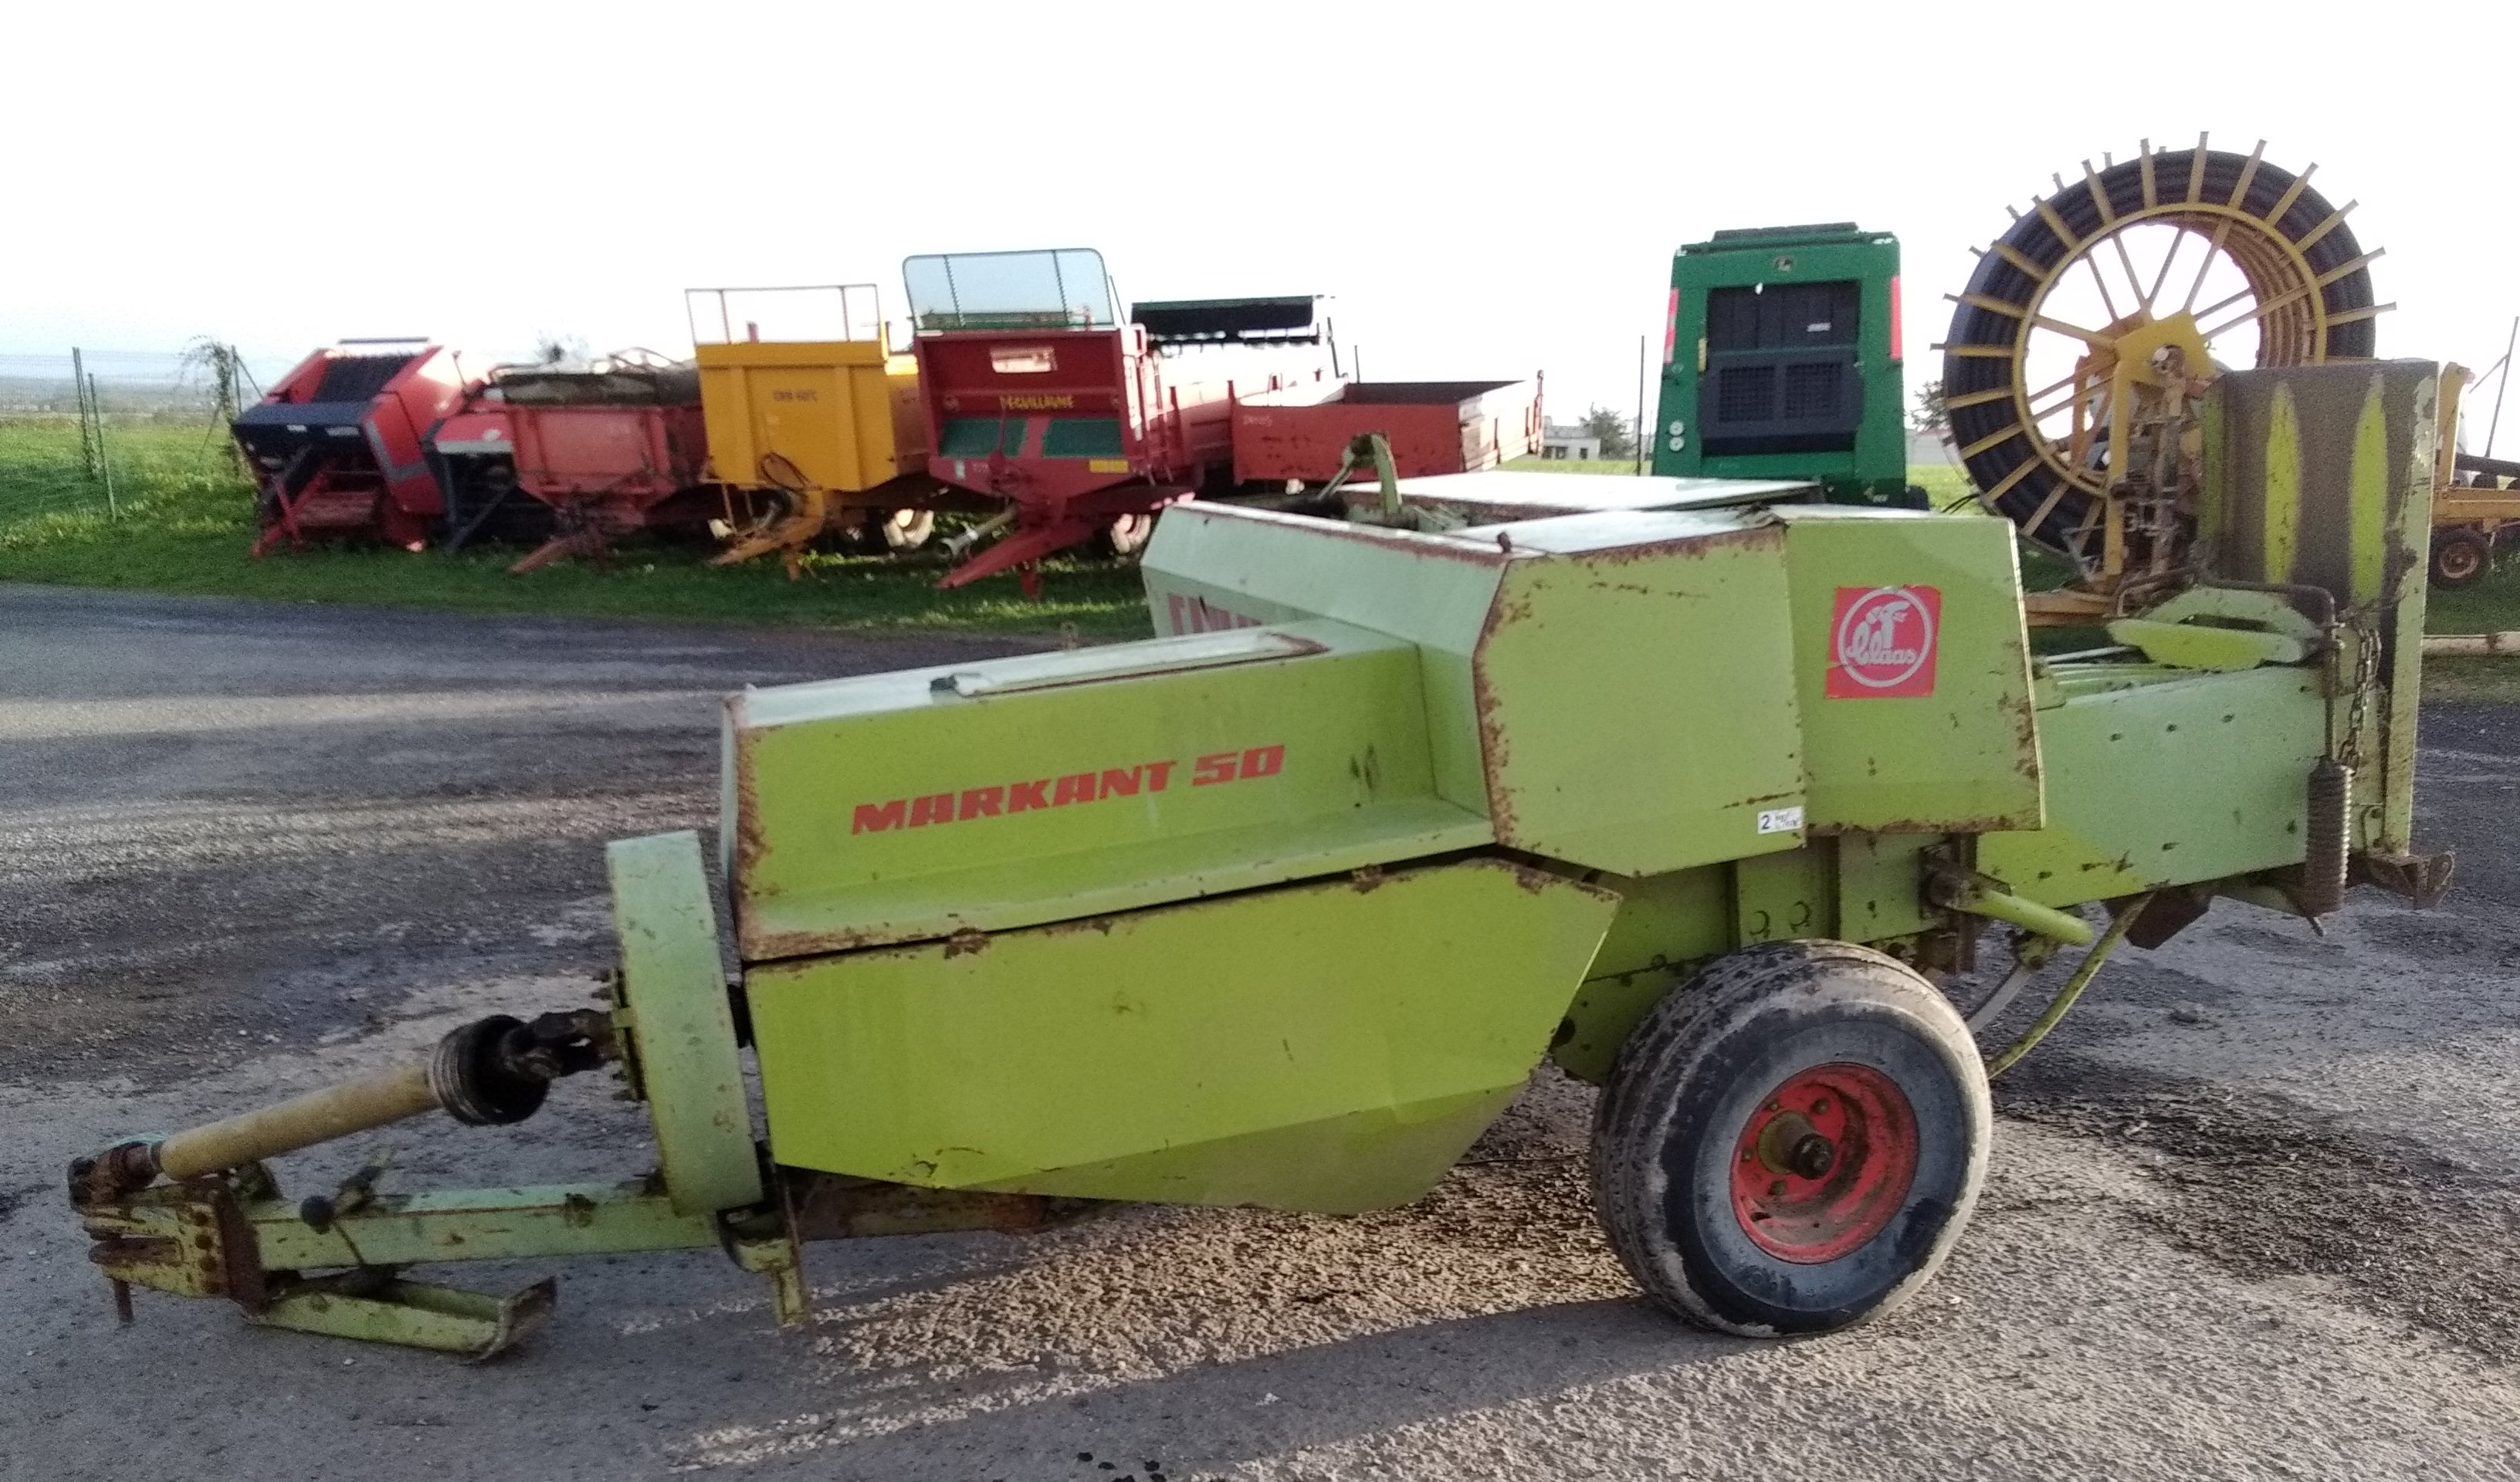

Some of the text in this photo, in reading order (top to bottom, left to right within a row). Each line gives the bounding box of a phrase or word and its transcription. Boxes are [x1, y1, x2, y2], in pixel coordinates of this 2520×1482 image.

[852, 745, 1285, 835] MARKANT 50
[1761, 814, 1771, 830] 2
